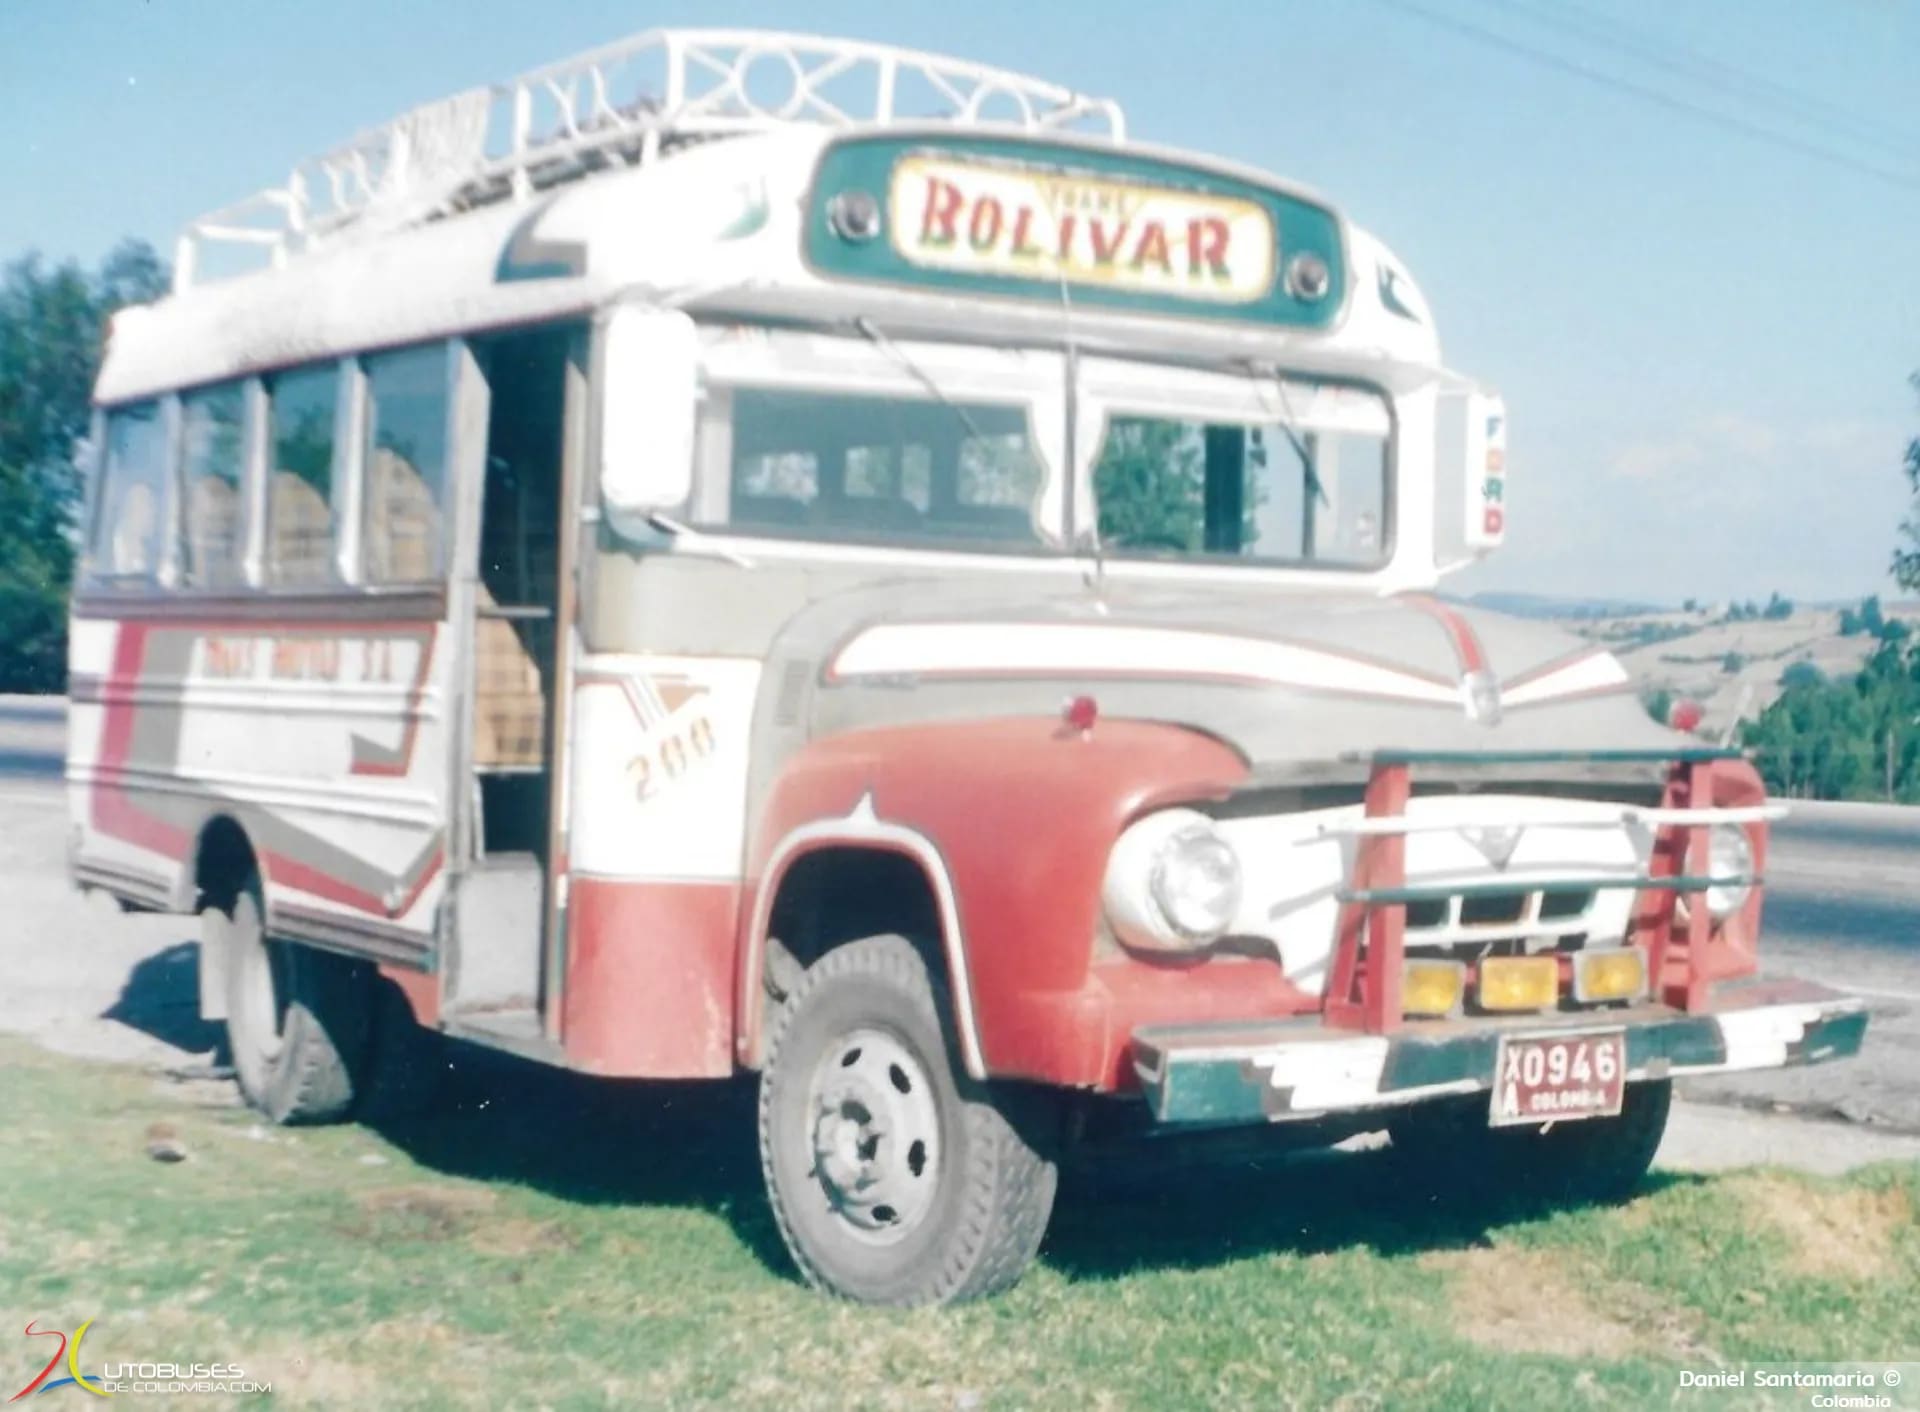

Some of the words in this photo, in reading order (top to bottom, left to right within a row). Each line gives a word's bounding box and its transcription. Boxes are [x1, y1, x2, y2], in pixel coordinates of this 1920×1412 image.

[919, 175, 1232, 284] BOLIVAR
[625, 716, 716, 803] 200
[1523, 1042, 1617, 1088] 0946
